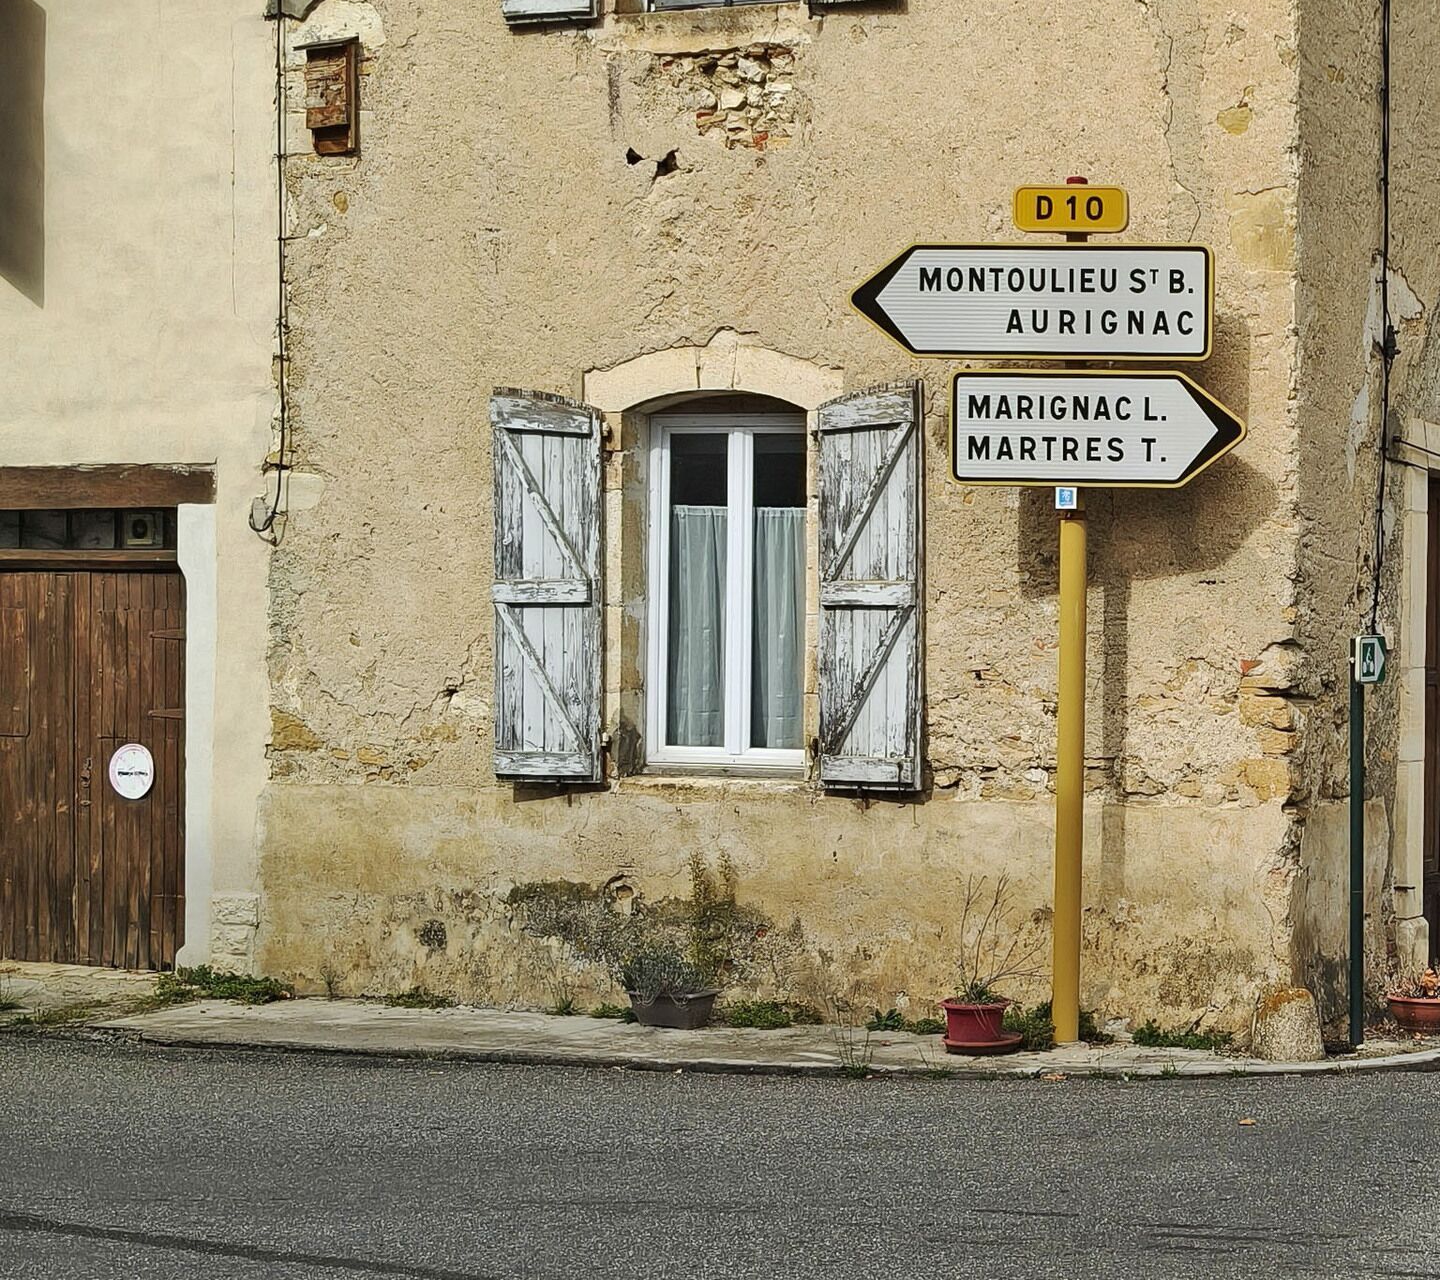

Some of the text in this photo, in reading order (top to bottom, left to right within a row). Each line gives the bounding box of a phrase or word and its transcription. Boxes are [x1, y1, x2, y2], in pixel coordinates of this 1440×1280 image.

[919, 267, 1117, 293] MONTOULIEU
[1169, 269, 1194, 294] B.
[1005, 309, 1194, 336] AURIGNAC
[968, 394, 1167, 421] MARIGNAC L.
[968, 435, 1167, 462] MARTRES T.
